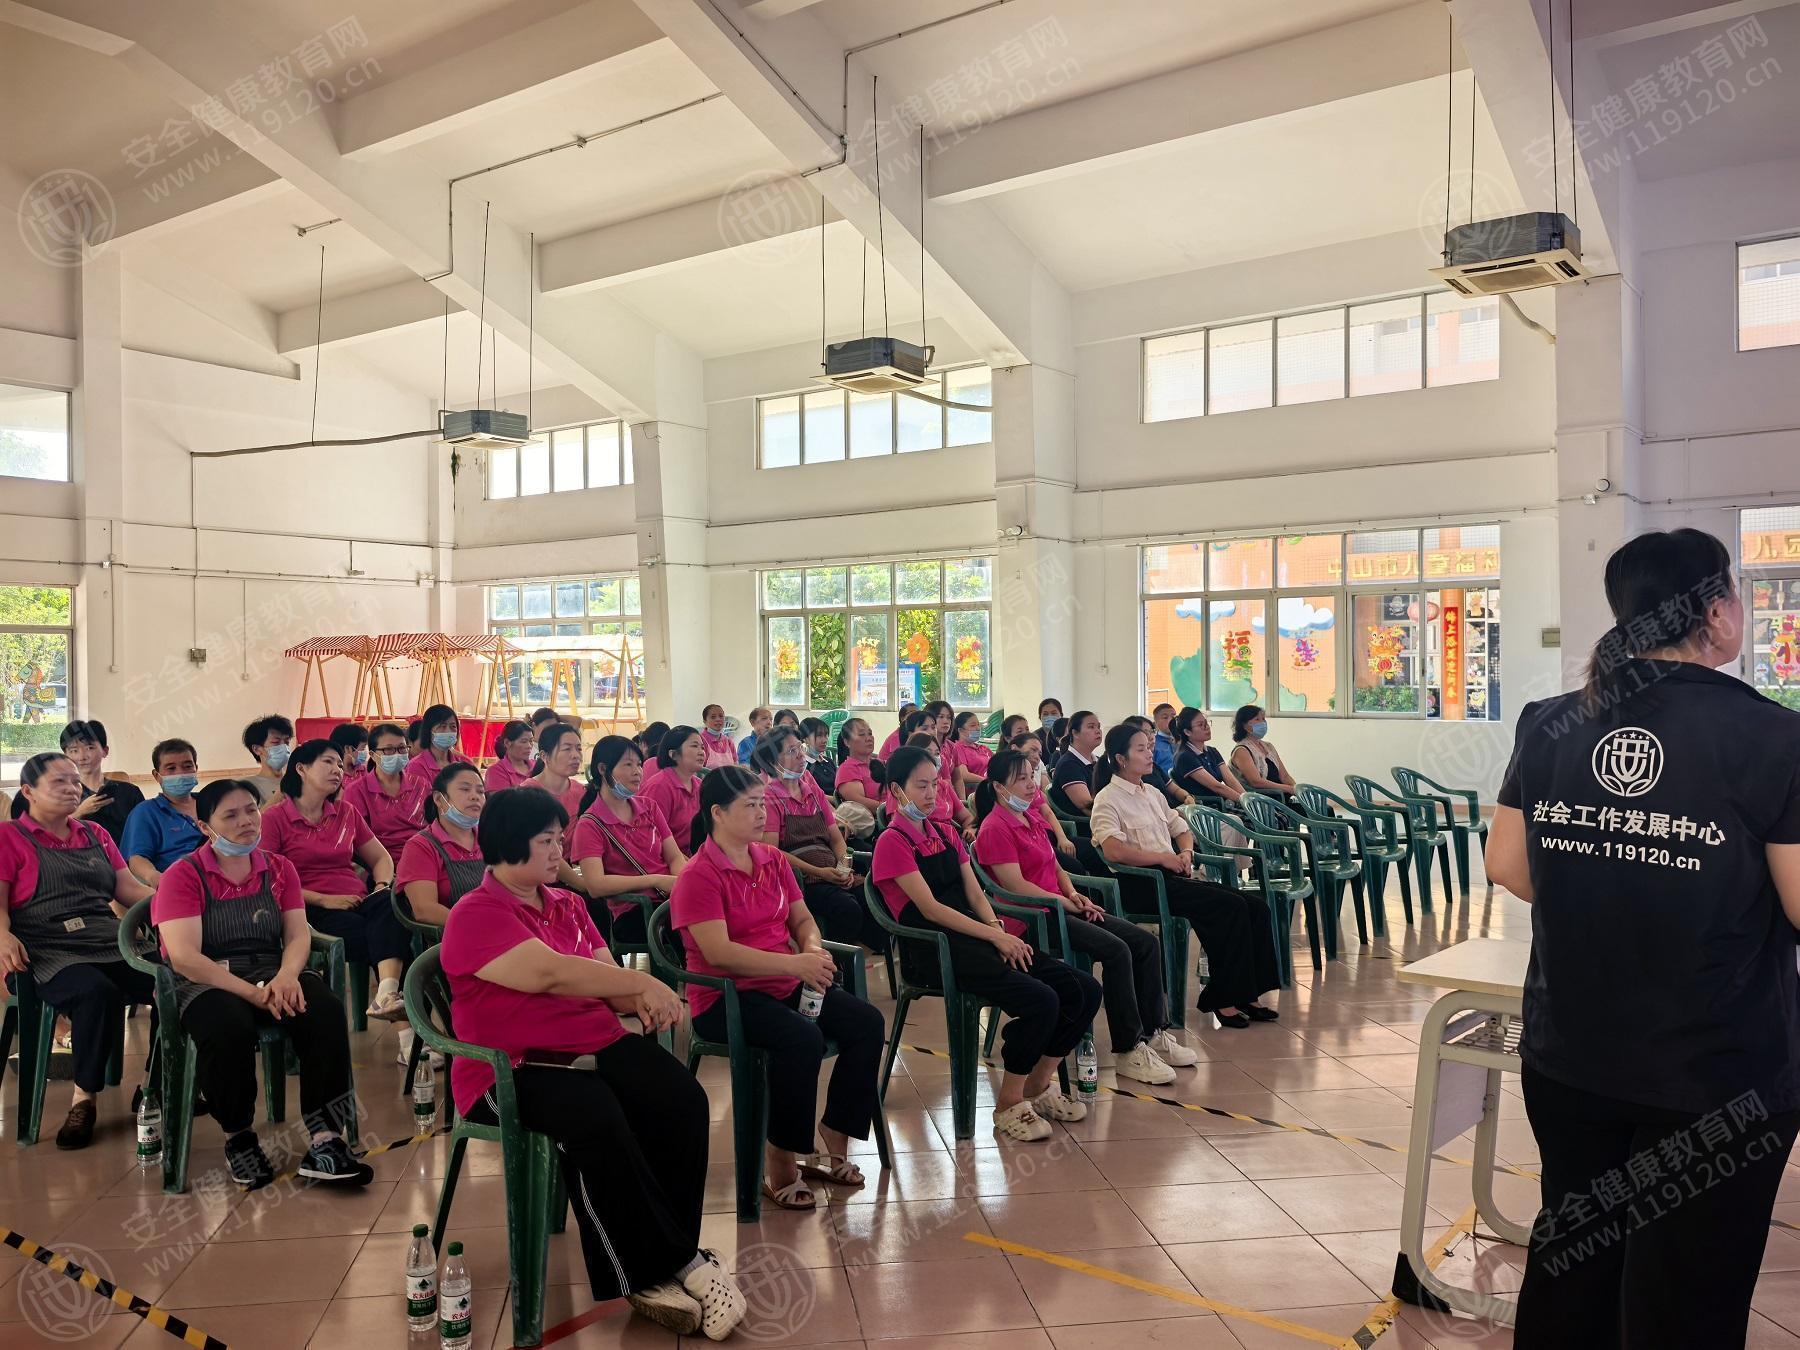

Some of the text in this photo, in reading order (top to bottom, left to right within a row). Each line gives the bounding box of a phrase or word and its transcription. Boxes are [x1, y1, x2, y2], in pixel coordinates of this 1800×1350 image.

[1532, 800, 1726, 846] 社会工作发展中心
[1541, 834, 1701, 871] www.119120.cn
